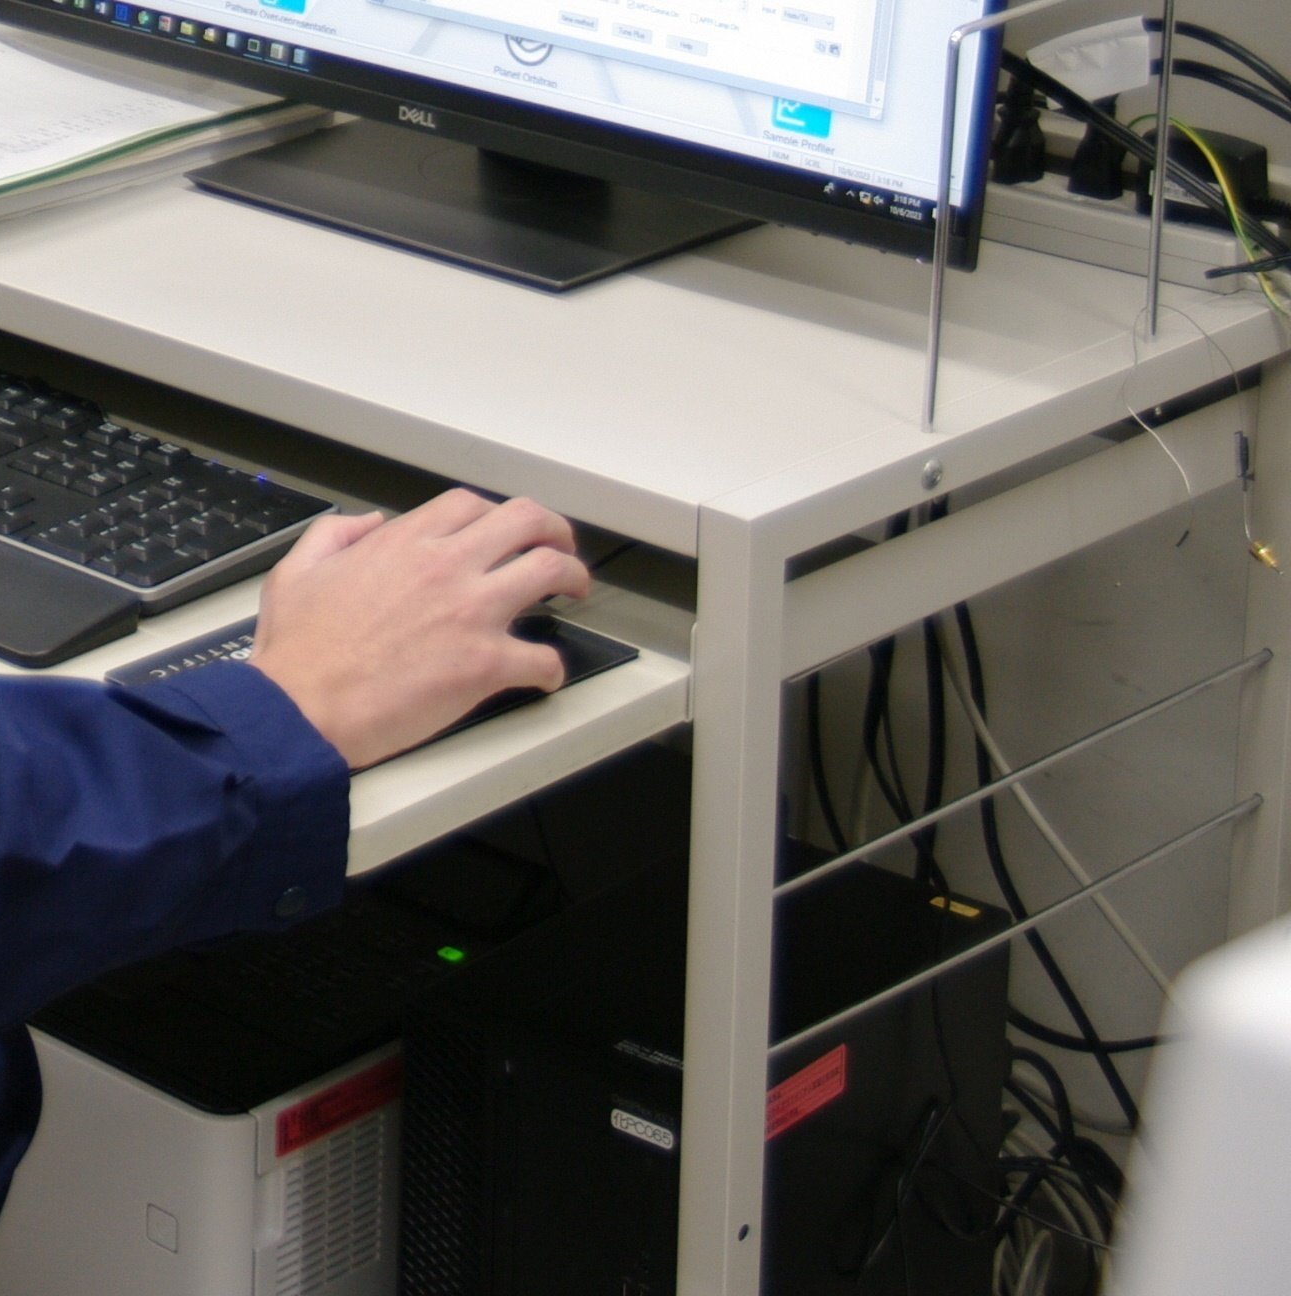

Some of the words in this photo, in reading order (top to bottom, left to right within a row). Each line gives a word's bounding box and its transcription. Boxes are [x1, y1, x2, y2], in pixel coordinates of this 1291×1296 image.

[224, 1, 258, 18] Pathway
[259, 8, 337, 36] Over-representation
[493, 65, 521, 81] Planet
[398, 105, 437, 129] DELL
[762, 130, 799, 147] Sample
[801, 138, 835, 155] Profiler
[908, 196, 921, 207] PM
